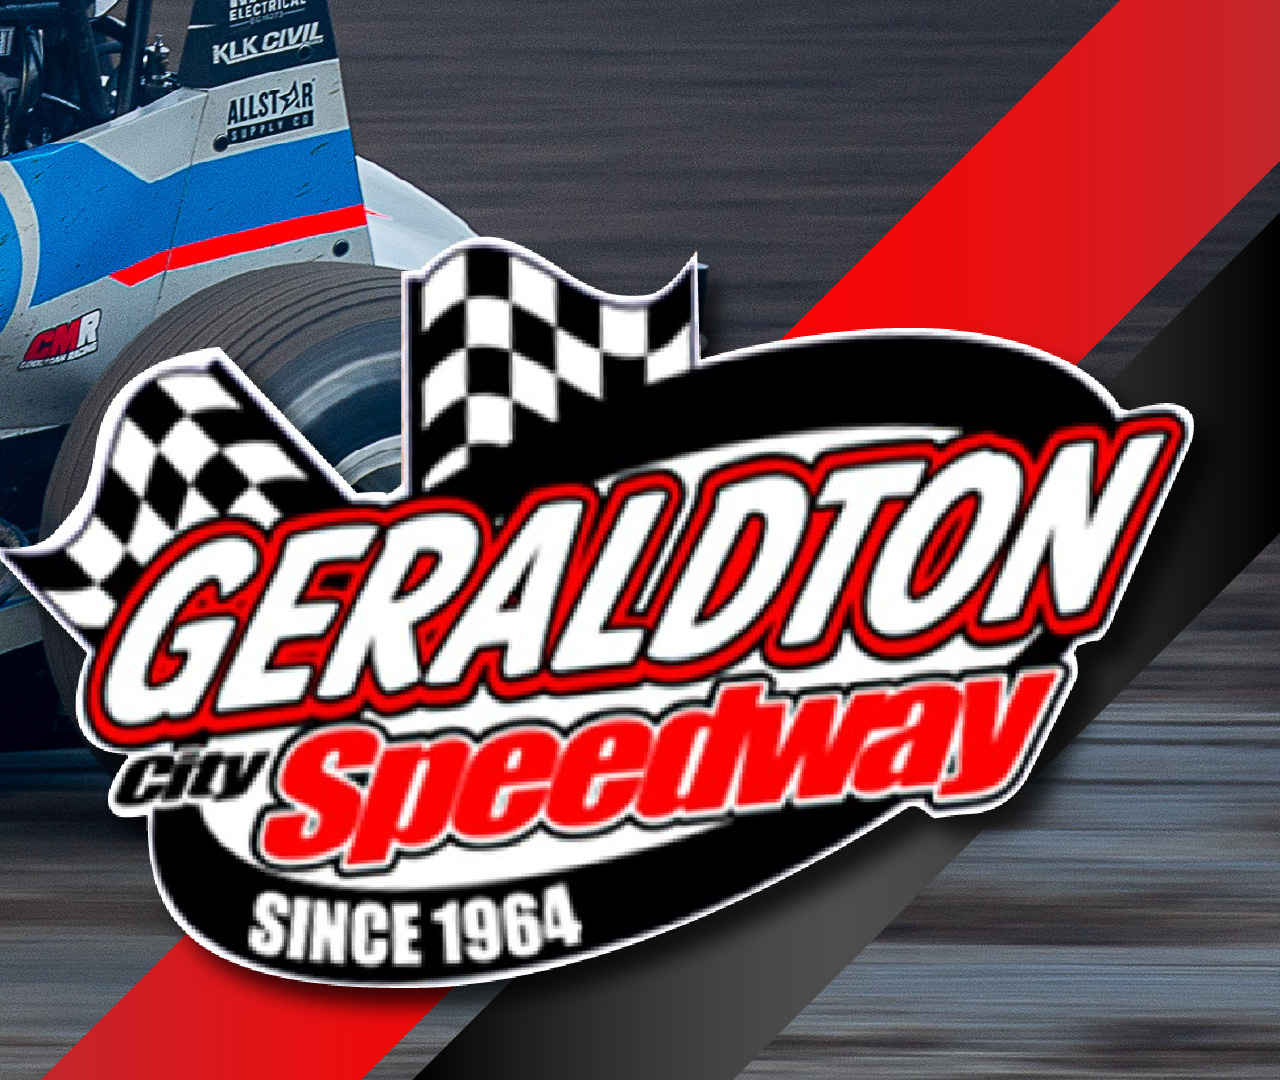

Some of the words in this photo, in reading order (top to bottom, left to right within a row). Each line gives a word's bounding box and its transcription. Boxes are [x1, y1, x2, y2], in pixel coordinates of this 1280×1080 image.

[212, 34, 259, 65] KLK
[261, 21, 324, 51] CIVIL
[230, 120, 284, 142] SUPPLY
[292, 114, 310, 127] CO
[23, 309, 101, 362] CMR
